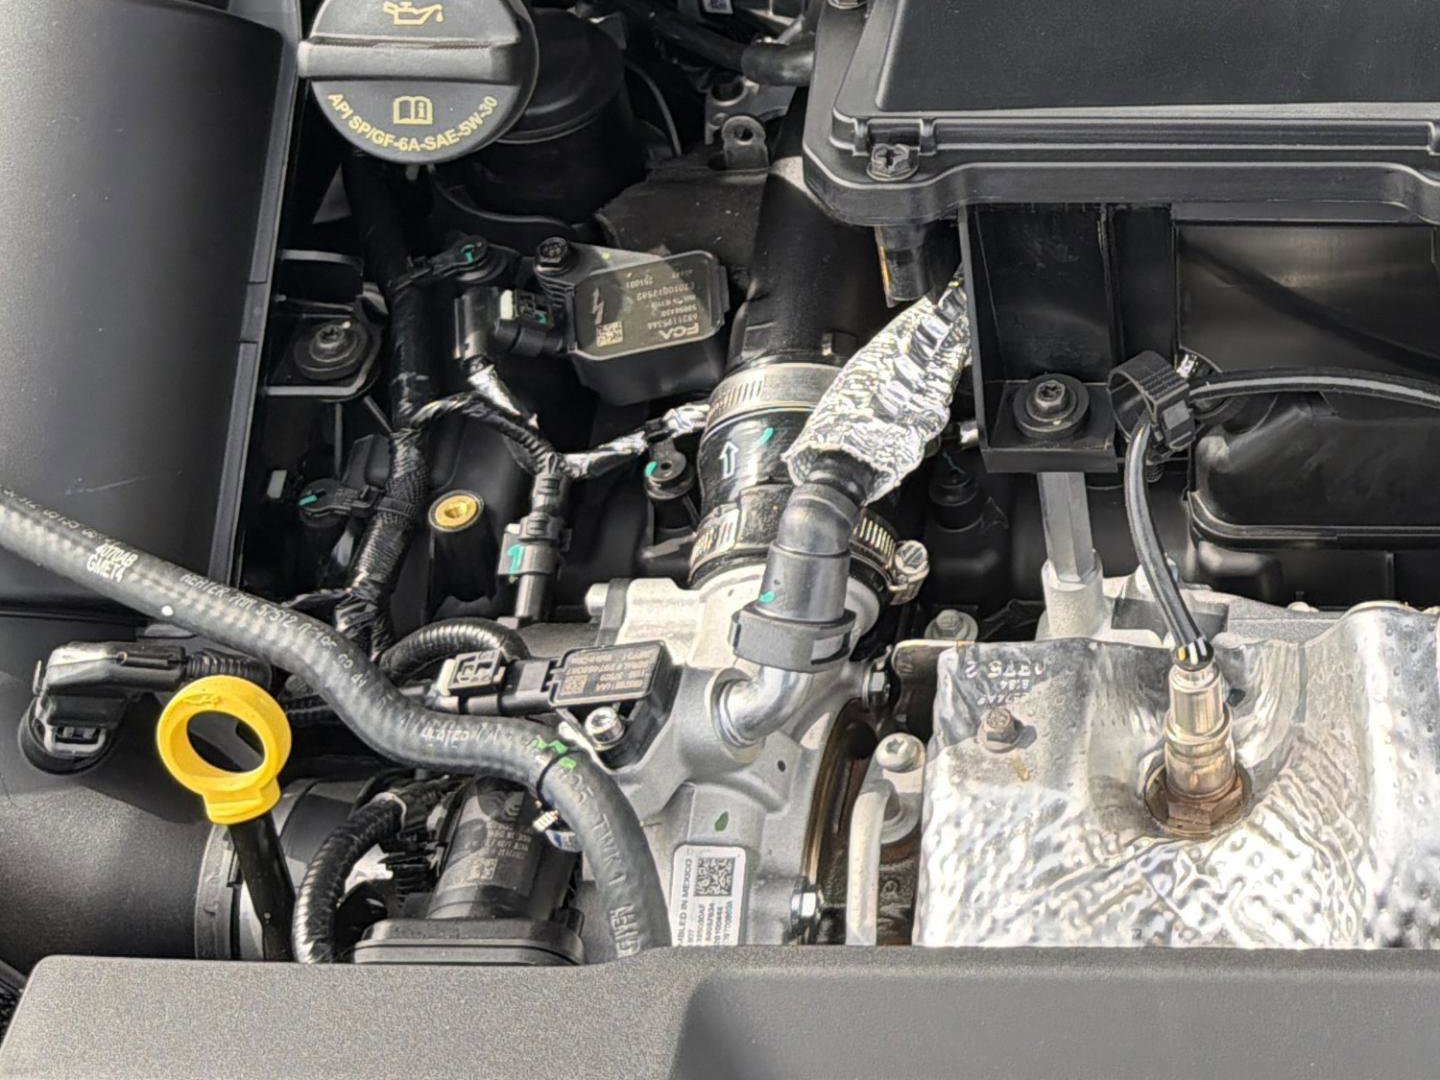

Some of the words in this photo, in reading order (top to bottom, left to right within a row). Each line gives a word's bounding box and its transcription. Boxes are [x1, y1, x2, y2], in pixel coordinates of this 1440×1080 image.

[328, 92, 352, 120] API
[348, 95, 498, 152] SP/GF-6A-SAE-5W-30
[659, 322, 699, 340] FCA
[681, 858, 693, 897] MEXICO
